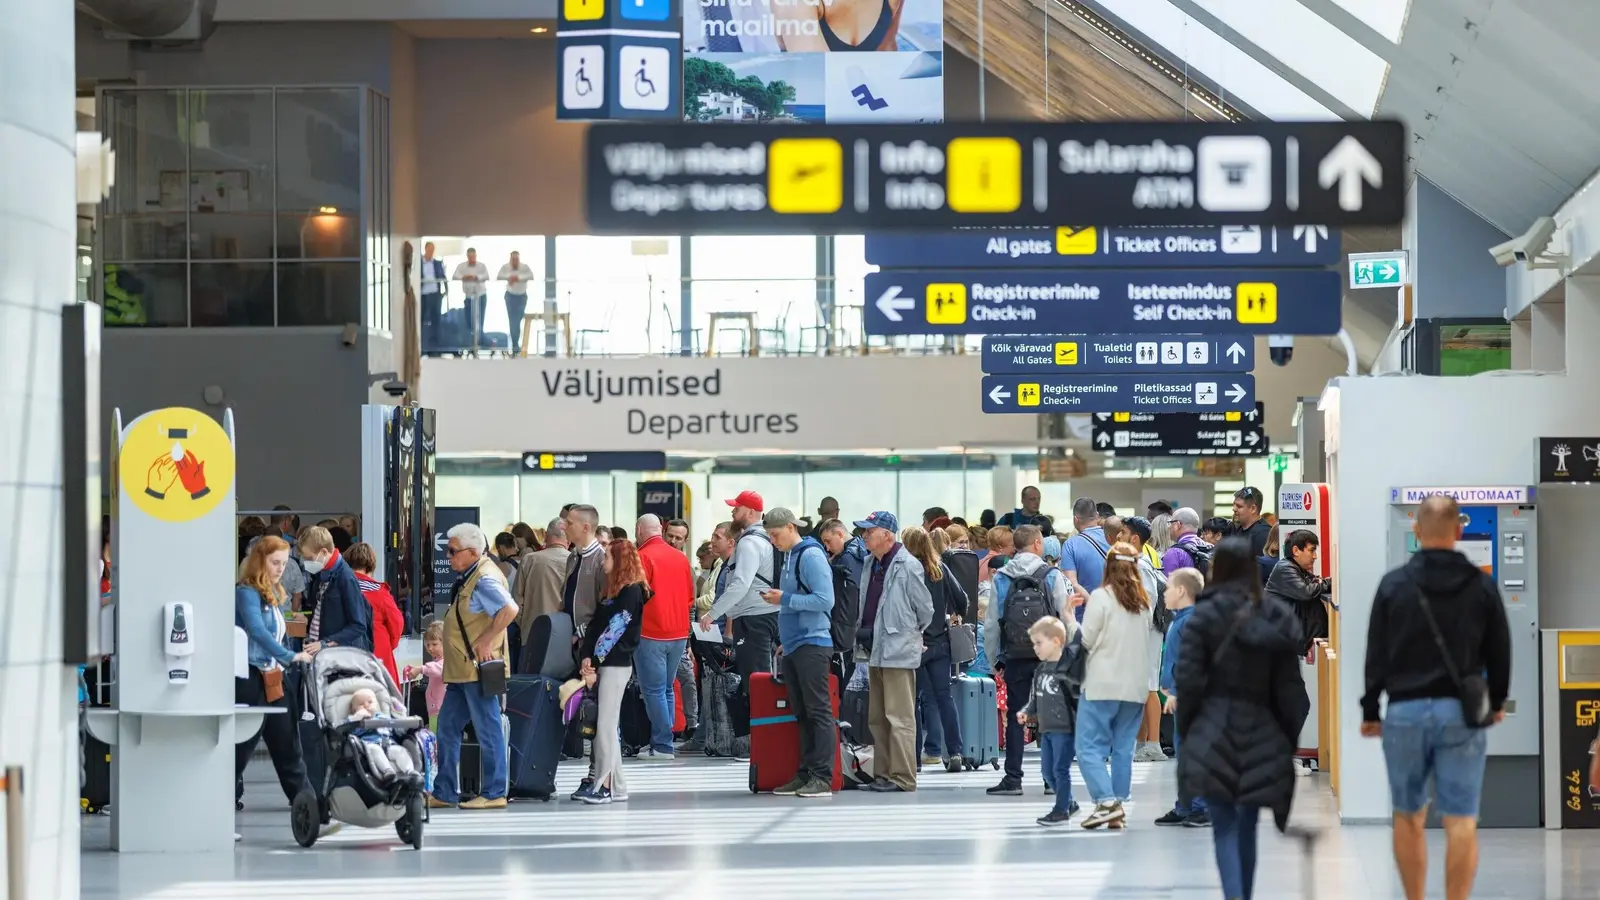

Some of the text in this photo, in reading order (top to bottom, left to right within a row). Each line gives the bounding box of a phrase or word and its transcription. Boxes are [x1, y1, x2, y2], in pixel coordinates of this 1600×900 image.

[700, 14, 819, 36] maailma
[880, 140, 945, 174] Info
[1059, 139, 1194, 174] Sularaha
[885, 177, 945, 210] Info
[1132, 176, 1194, 209] ATM
[986, 237, 1052, 258] All gates
[1114, 236, 1217, 253] Ticket Offices
[971, 283, 1100, 303] Registreerimine
[1128, 283, 1232, 300] Iseteenindus
[972, 305, 1036, 321] Check-in
[1133, 304, 1232, 321] Self Check-in
[991, 343, 1052, 353] Kõik väravad
[1094, 343, 1133, 352] Tualetid
[1012, 355, 1052, 364] All Gates
[1103, 355, 1133, 364] Toilets
[542, 368, 721, 403] Väljumised
[1043, 384, 1118, 395] Registreerimine
[1134, 383, 1192, 393] Piletikassad
[1043, 396, 1081, 405] Check-in
[1133, 395, 1192, 404] Ticket Offices
[627, 409, 799, 440] Departures
[644, 492, 673, 504] LOT
[1282, 493, 1303, 501] TURKISH
[1282, 502, 1303, 510] AIRLINES
